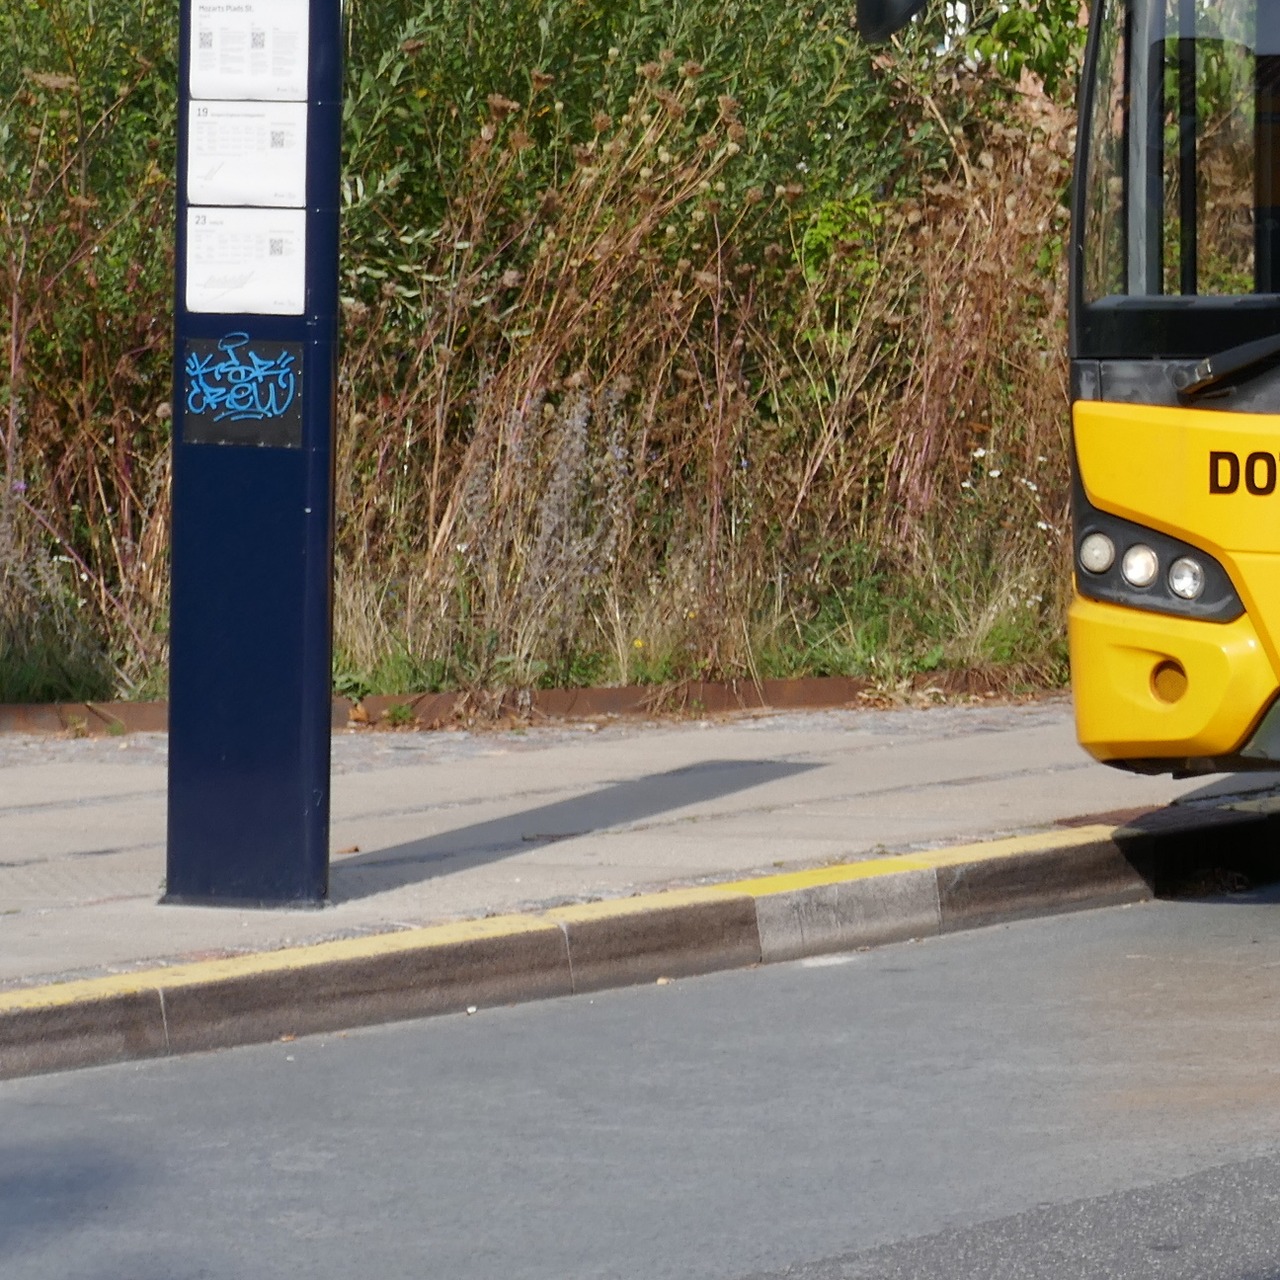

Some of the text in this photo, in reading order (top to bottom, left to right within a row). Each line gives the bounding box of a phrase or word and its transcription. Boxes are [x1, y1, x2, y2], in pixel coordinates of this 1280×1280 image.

[199, 5, 224, 13] Mozarts
[197, 107, 209, 117] 19
[195, 215, 207, 225] 23
